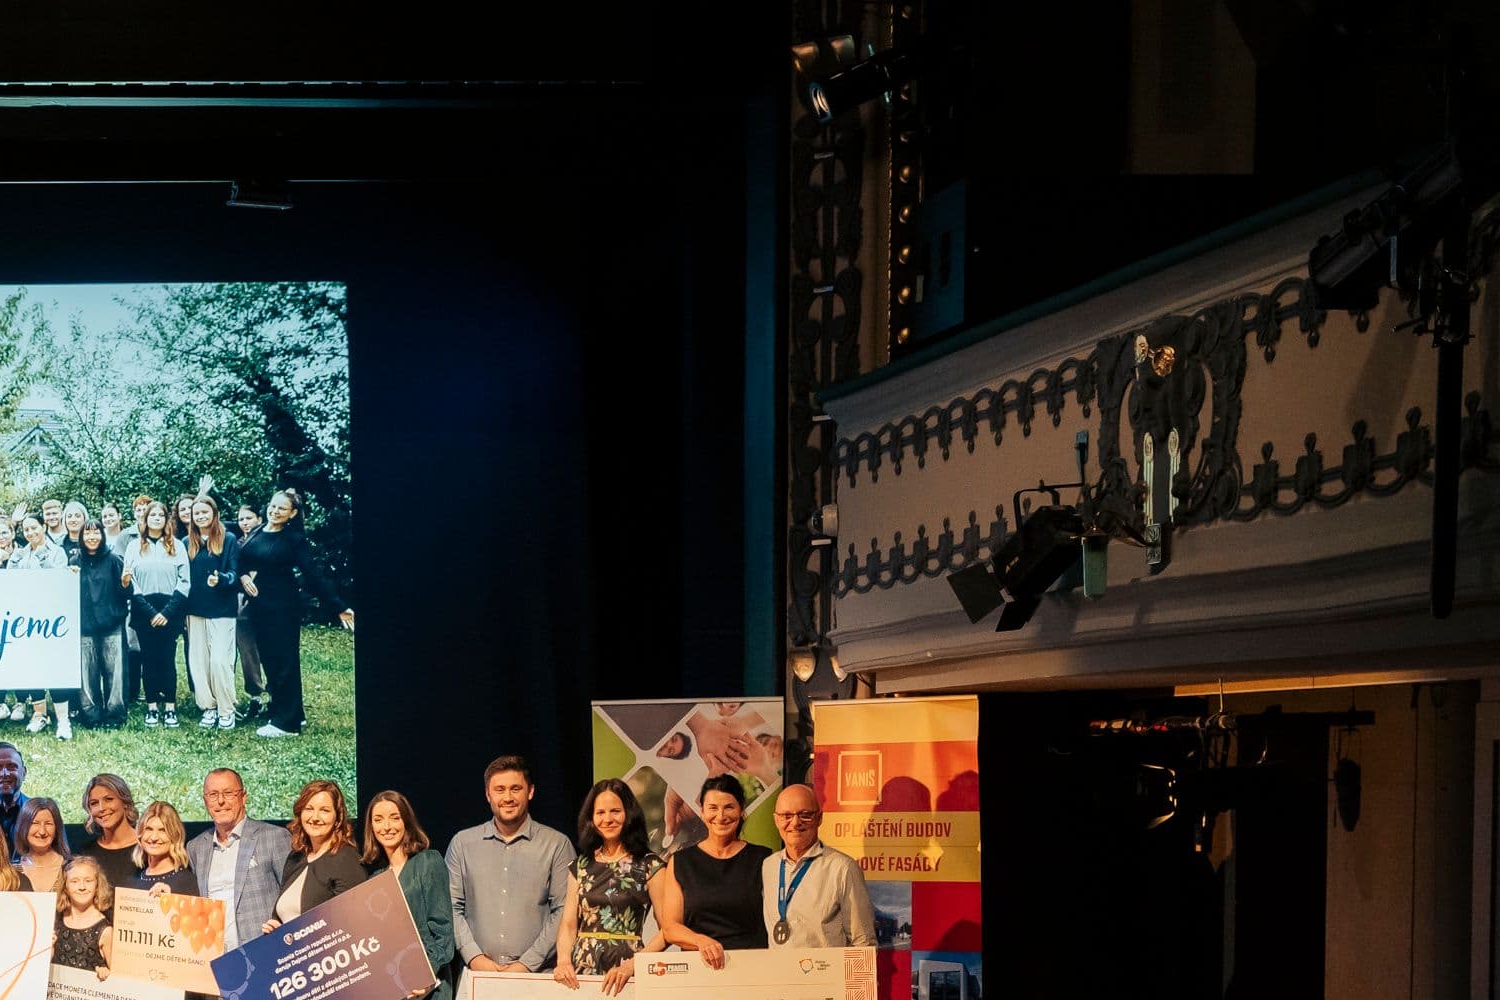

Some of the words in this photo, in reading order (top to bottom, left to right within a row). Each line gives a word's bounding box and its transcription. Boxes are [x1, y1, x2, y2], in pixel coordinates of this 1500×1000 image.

[845, 769, 876, 787] VANIS
[835, 819, 903, 838] OPLÁŠTĚNÍ
[906, 822, 951, 838] BUDOV
[119, 906, 154, 914] KINSTELLAR
[118, 928, 153, 945] 111.111
[158, 934, 176, 948] Kč
[293, 919, 327, 941] SCANIA
[270, 970, 307, 1000] 126
[308, 949, 351, 981] 300
[351, 936, 380, 961] Kč
[64, 984, 86, 995] MONETA
